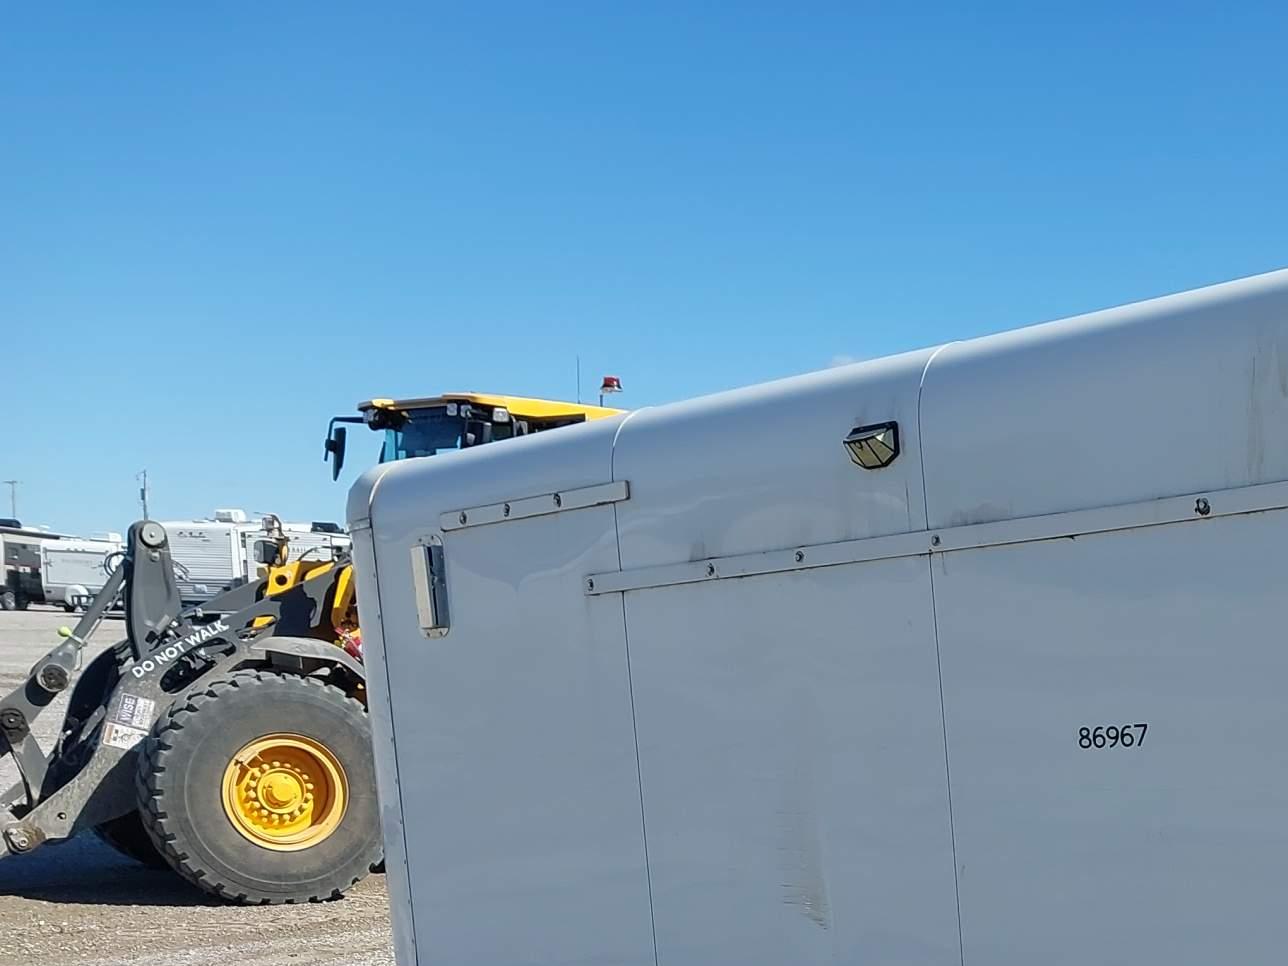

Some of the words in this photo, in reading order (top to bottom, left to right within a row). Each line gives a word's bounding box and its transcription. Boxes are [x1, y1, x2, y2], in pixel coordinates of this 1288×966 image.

[132, 660, 155, 678] DO
[155, 641, 185, 665] NOT
[185, 620, 230, 646] WALK
[1078, 723, 1148, 749] 86967
